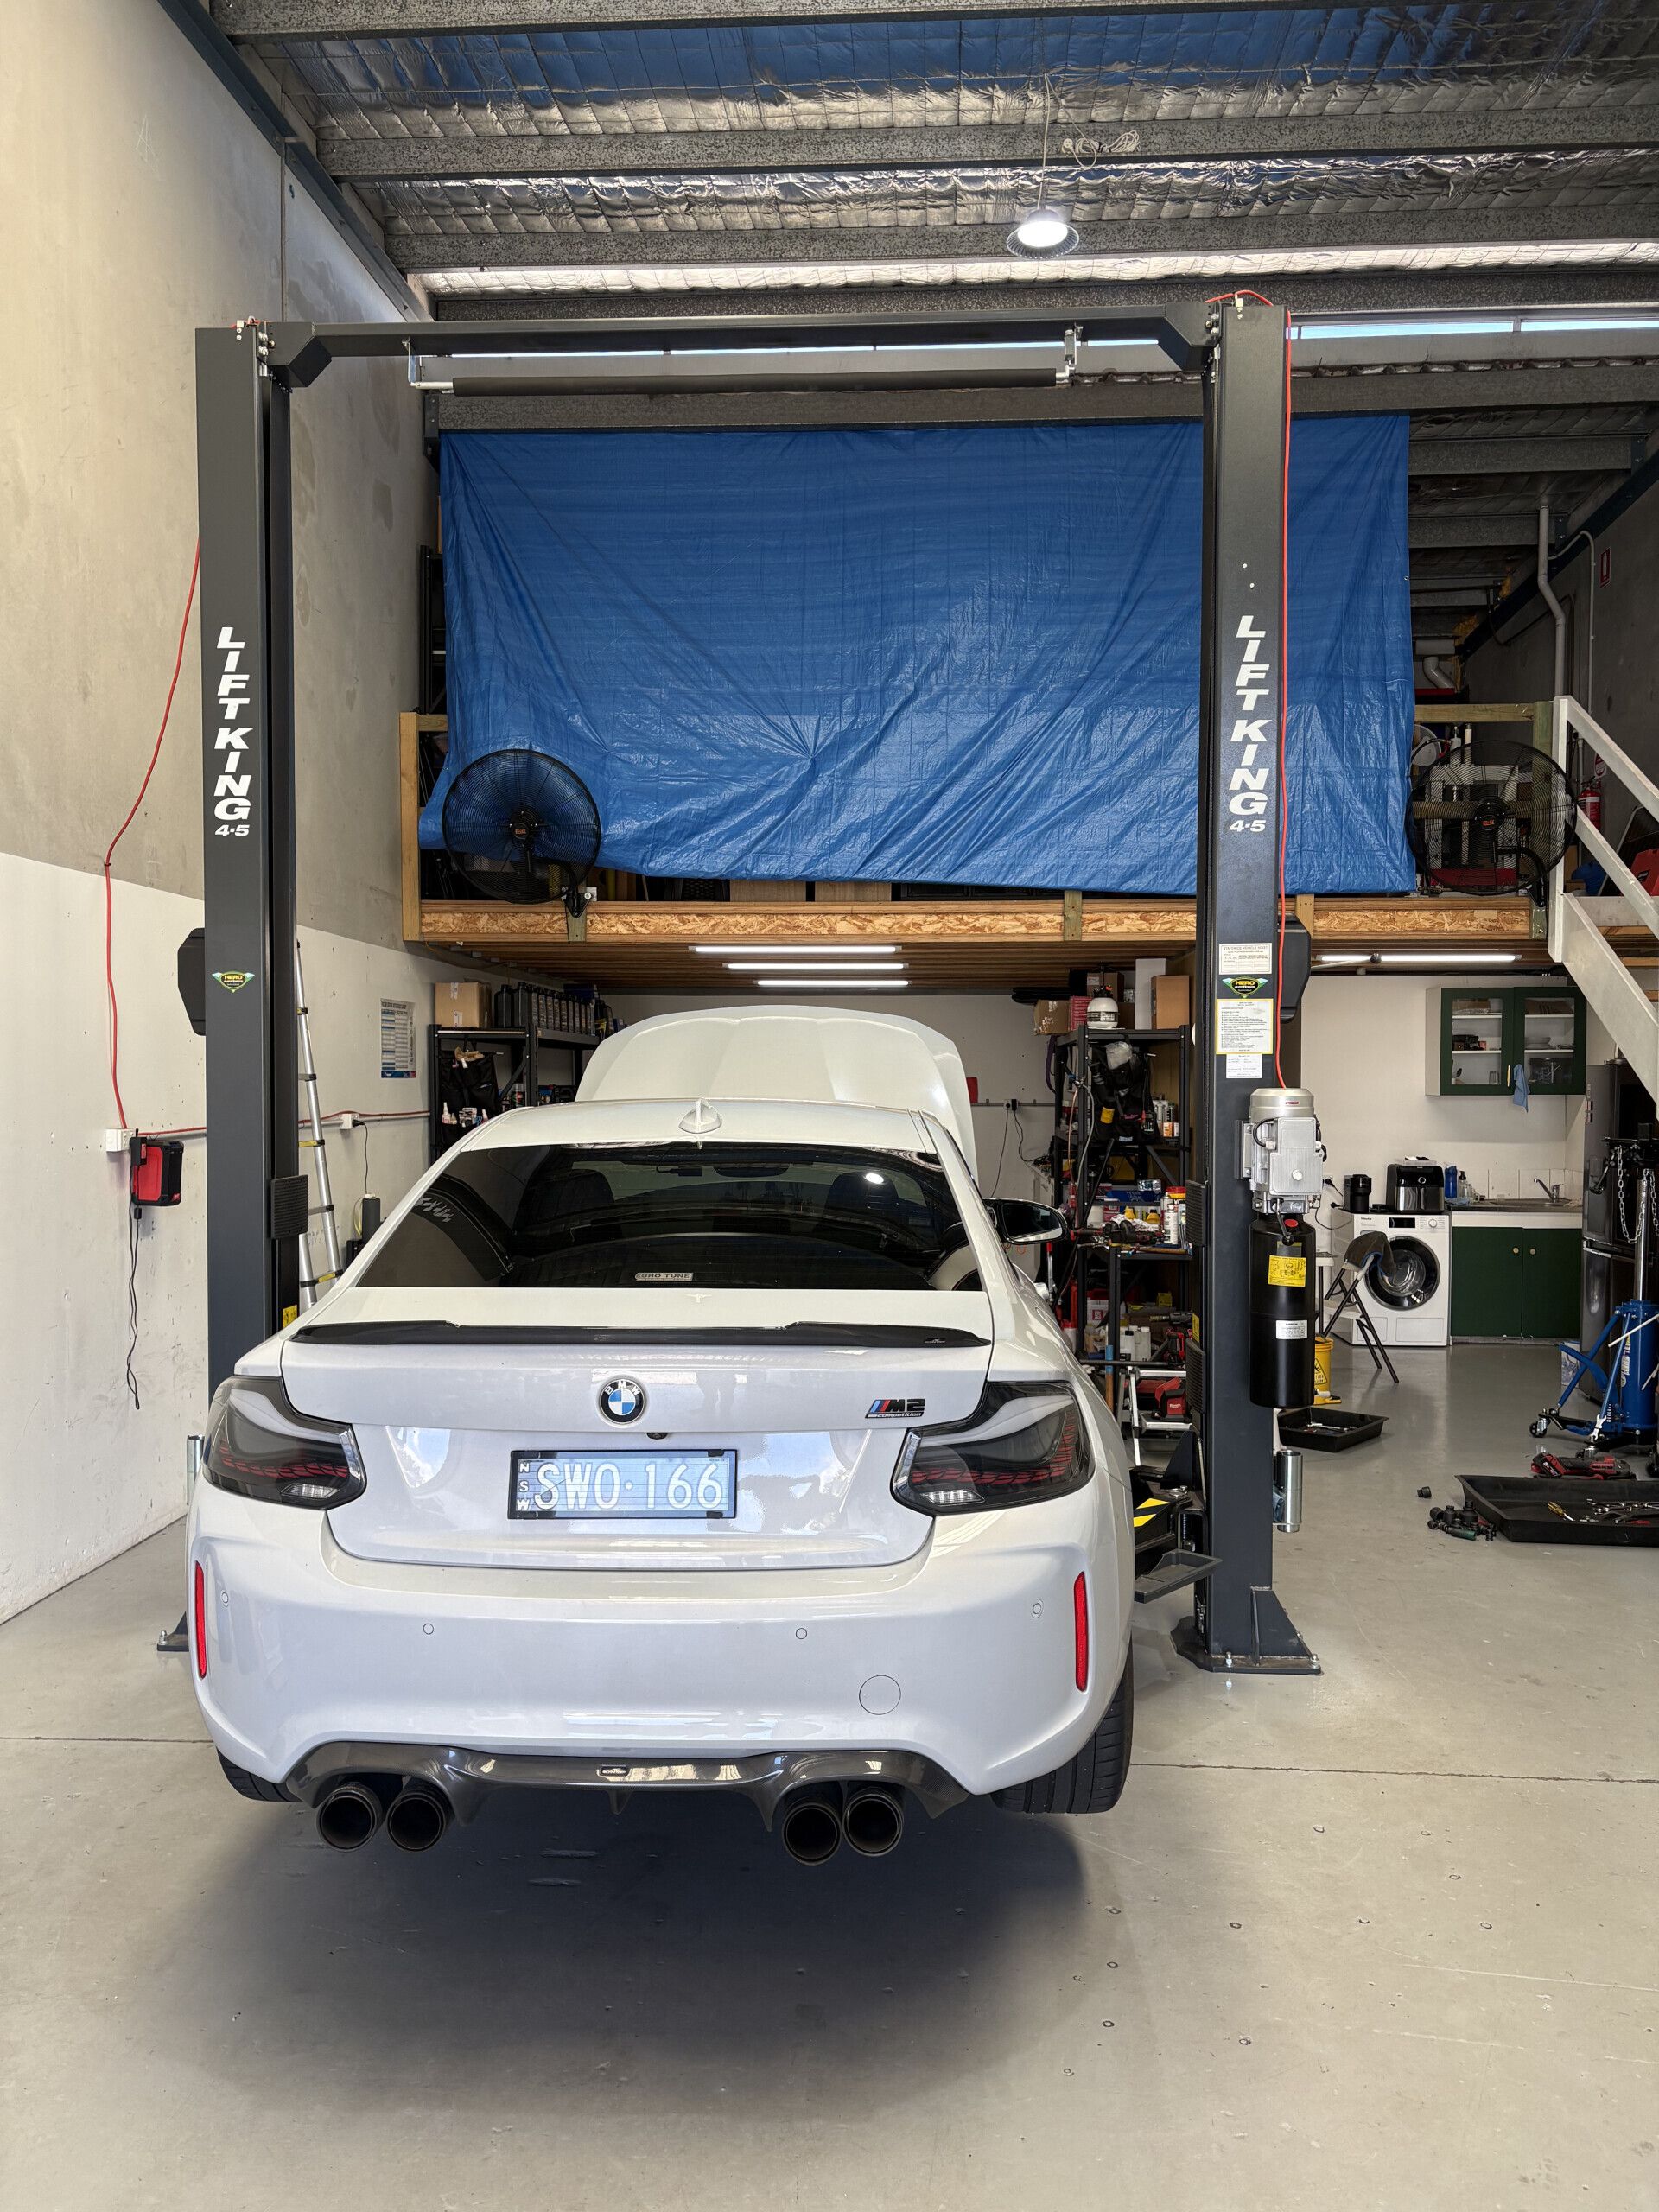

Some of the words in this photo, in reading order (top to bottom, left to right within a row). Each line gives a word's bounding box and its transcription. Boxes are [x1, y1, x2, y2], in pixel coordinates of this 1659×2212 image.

[217, 626, 251, 719] LIFT
[1235, 615, 1270, 710] LIFT
[213, 728, 254, 820] KING
[1228, 719, 1273, 815] KING
[884, 1399, 925, 1412] M2
